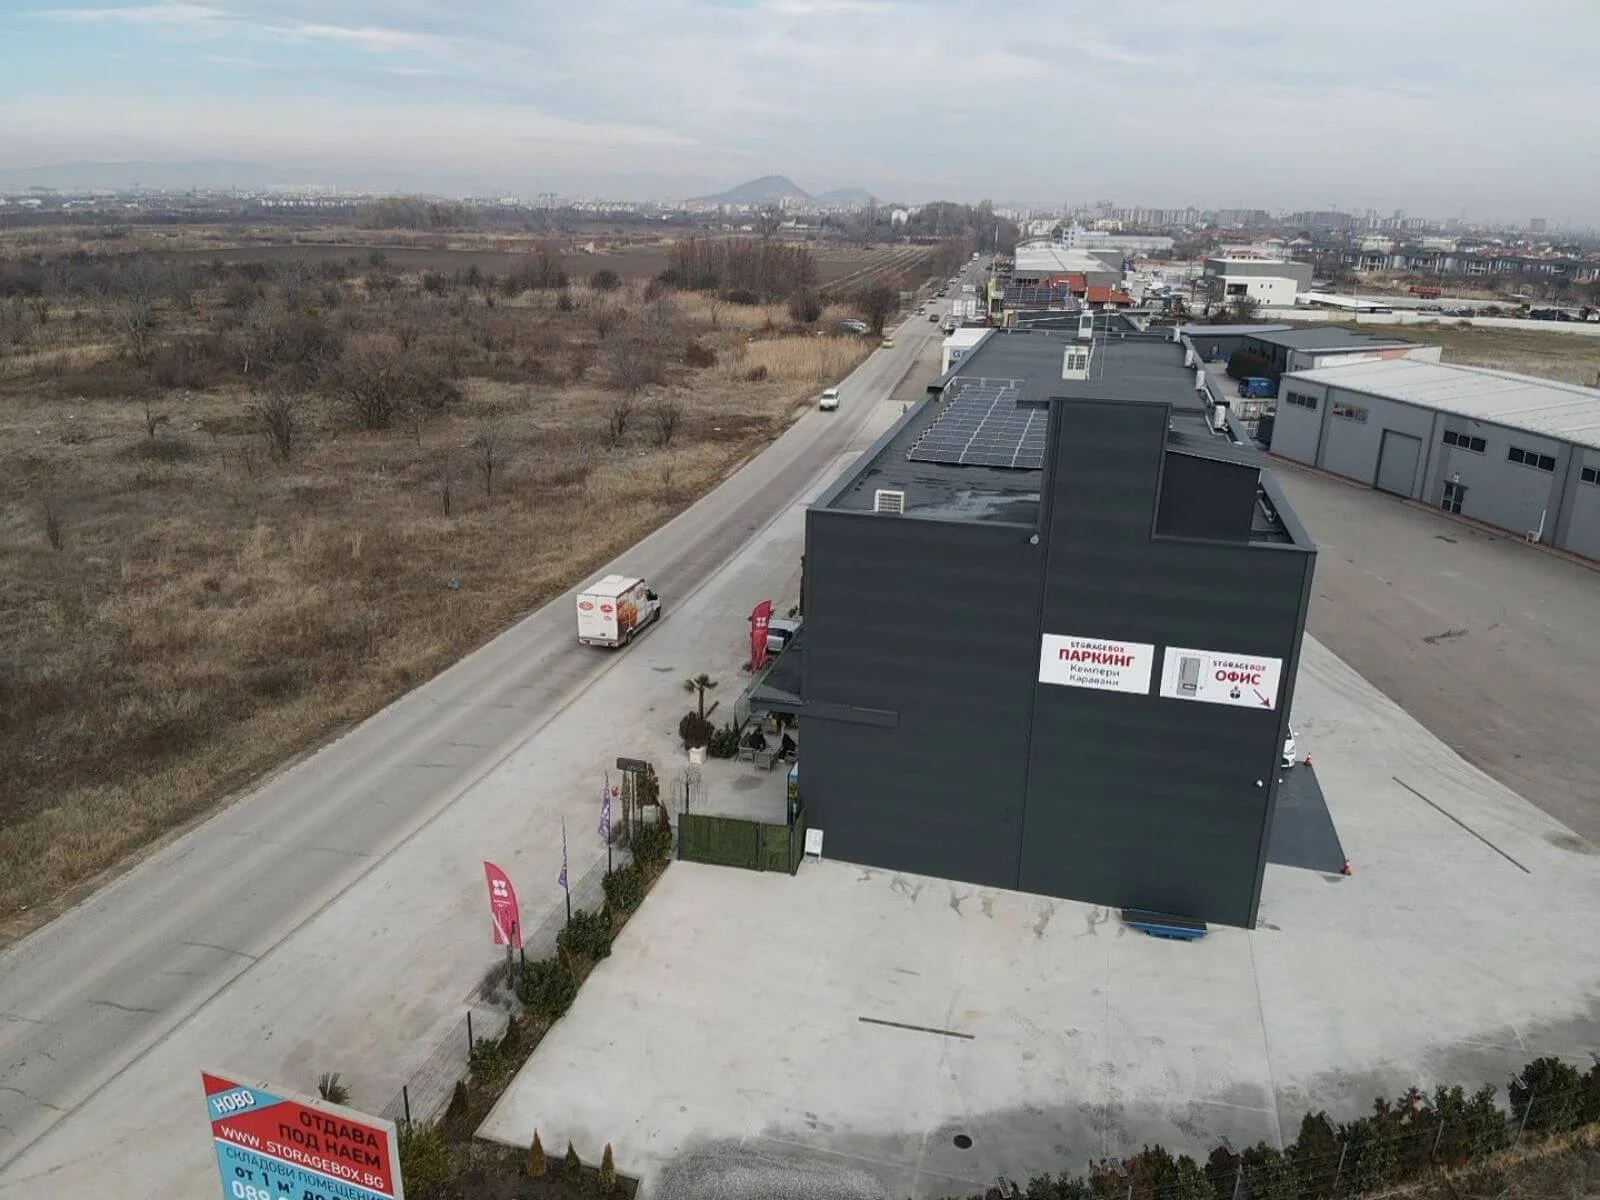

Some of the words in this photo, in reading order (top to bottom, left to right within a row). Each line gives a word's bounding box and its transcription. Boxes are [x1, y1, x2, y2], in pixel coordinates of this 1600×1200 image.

[1070, 641, 1125, 653] STORAGEBOX
[1058, 648, 1135, 667] ПАРКИНГ
[1070, 664, 1120, 677] Кемпери
[1213, 660, 1267, 671] STORAGEBOX
[1069, 675, 1119, 687] Каравани
[1215, 670, 1261, 685] ОФИС
[212, 1090, 256, 1115] НОВО
[299, 1111, 380, 1150] ОТДАВА
[278, 1123, 320, 1152] ПОД
[325, 1138, 381, 1169] НАЕМ
[225, 1147, 296, 1180] СКЛАДОВИ
[298, 1171, 386, 1200] ПОМЕЩЕНИ
[262, 1172, 270, 1187] 1
